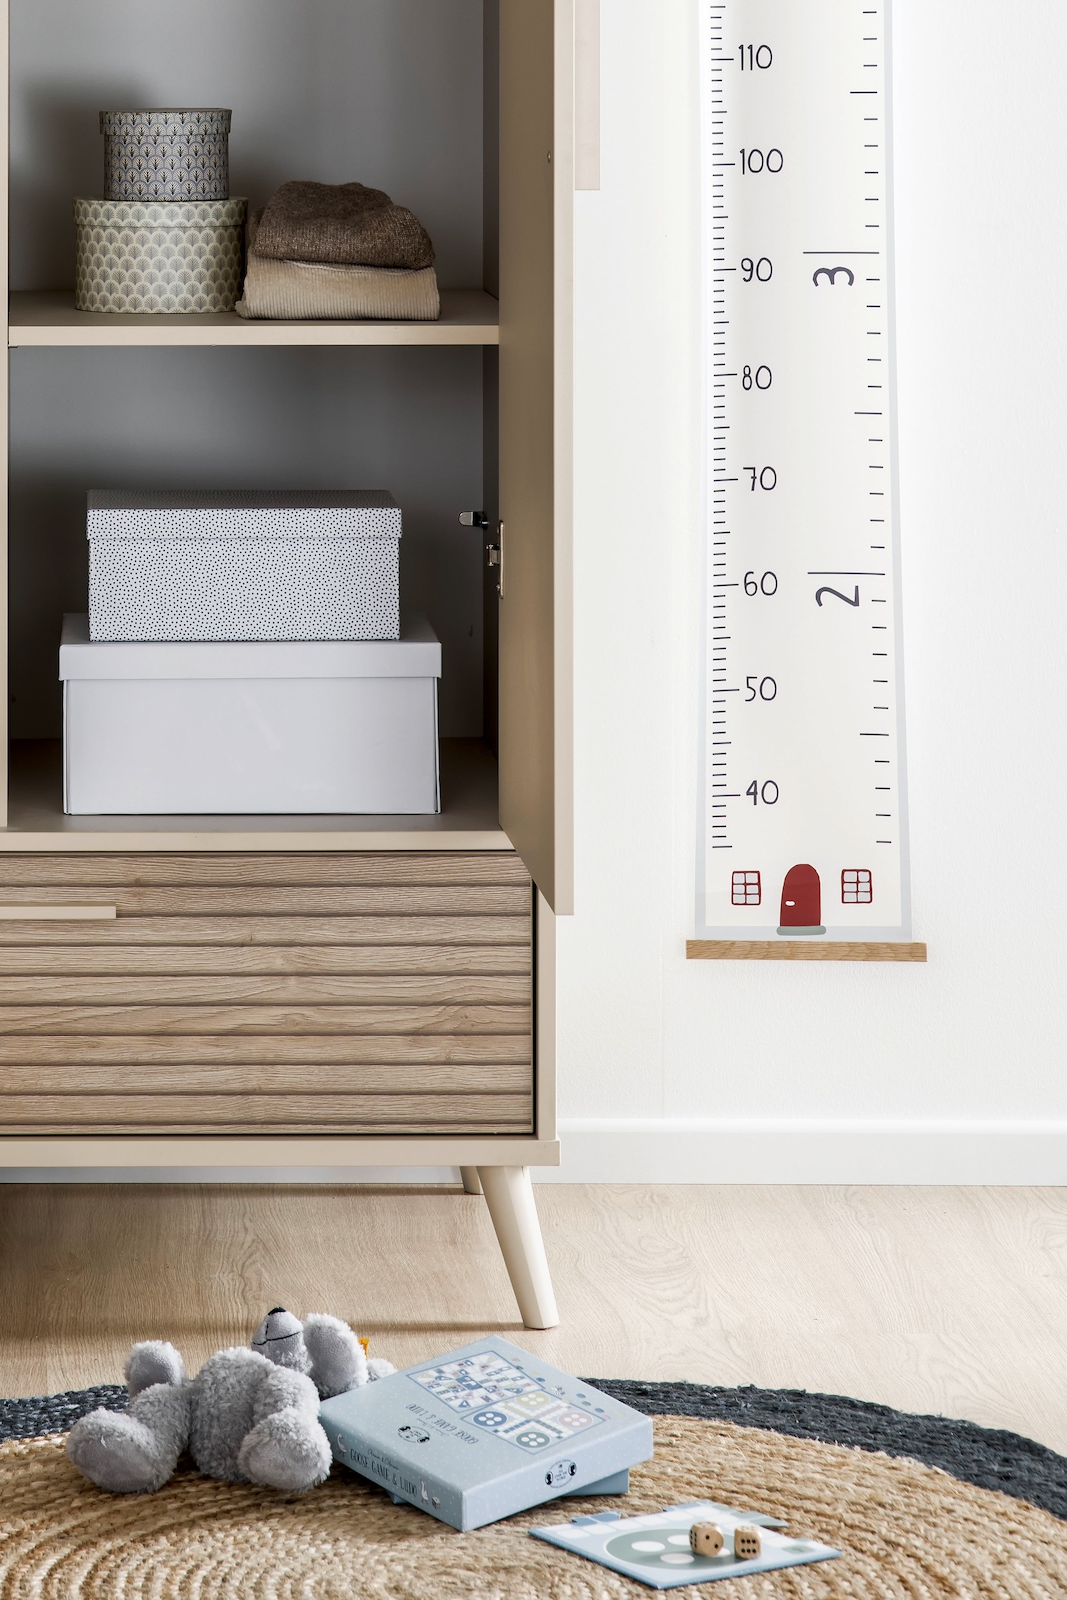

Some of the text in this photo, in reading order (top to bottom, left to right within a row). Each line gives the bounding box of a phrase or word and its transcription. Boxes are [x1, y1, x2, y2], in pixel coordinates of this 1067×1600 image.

[738, 44, 773, 71] 110
[739, 148, 784, 176] 100
[740, 257, 773, 283] 90
[812, 266, 855, 287] 3
[741, 364, 773, 391] 80
[742, 465, 777, 492] 70
[743, 570, 778, 597] 60
[815, 585, 860, 608] 2
[744, 675, 777, 702] 50
[745, 779, 779, 806] 40
[350, 1448, 370, 1470] GOOSE
[371, 1460, 391, 1482] GAME
[399, 1476, 418, 1498] LUDO
